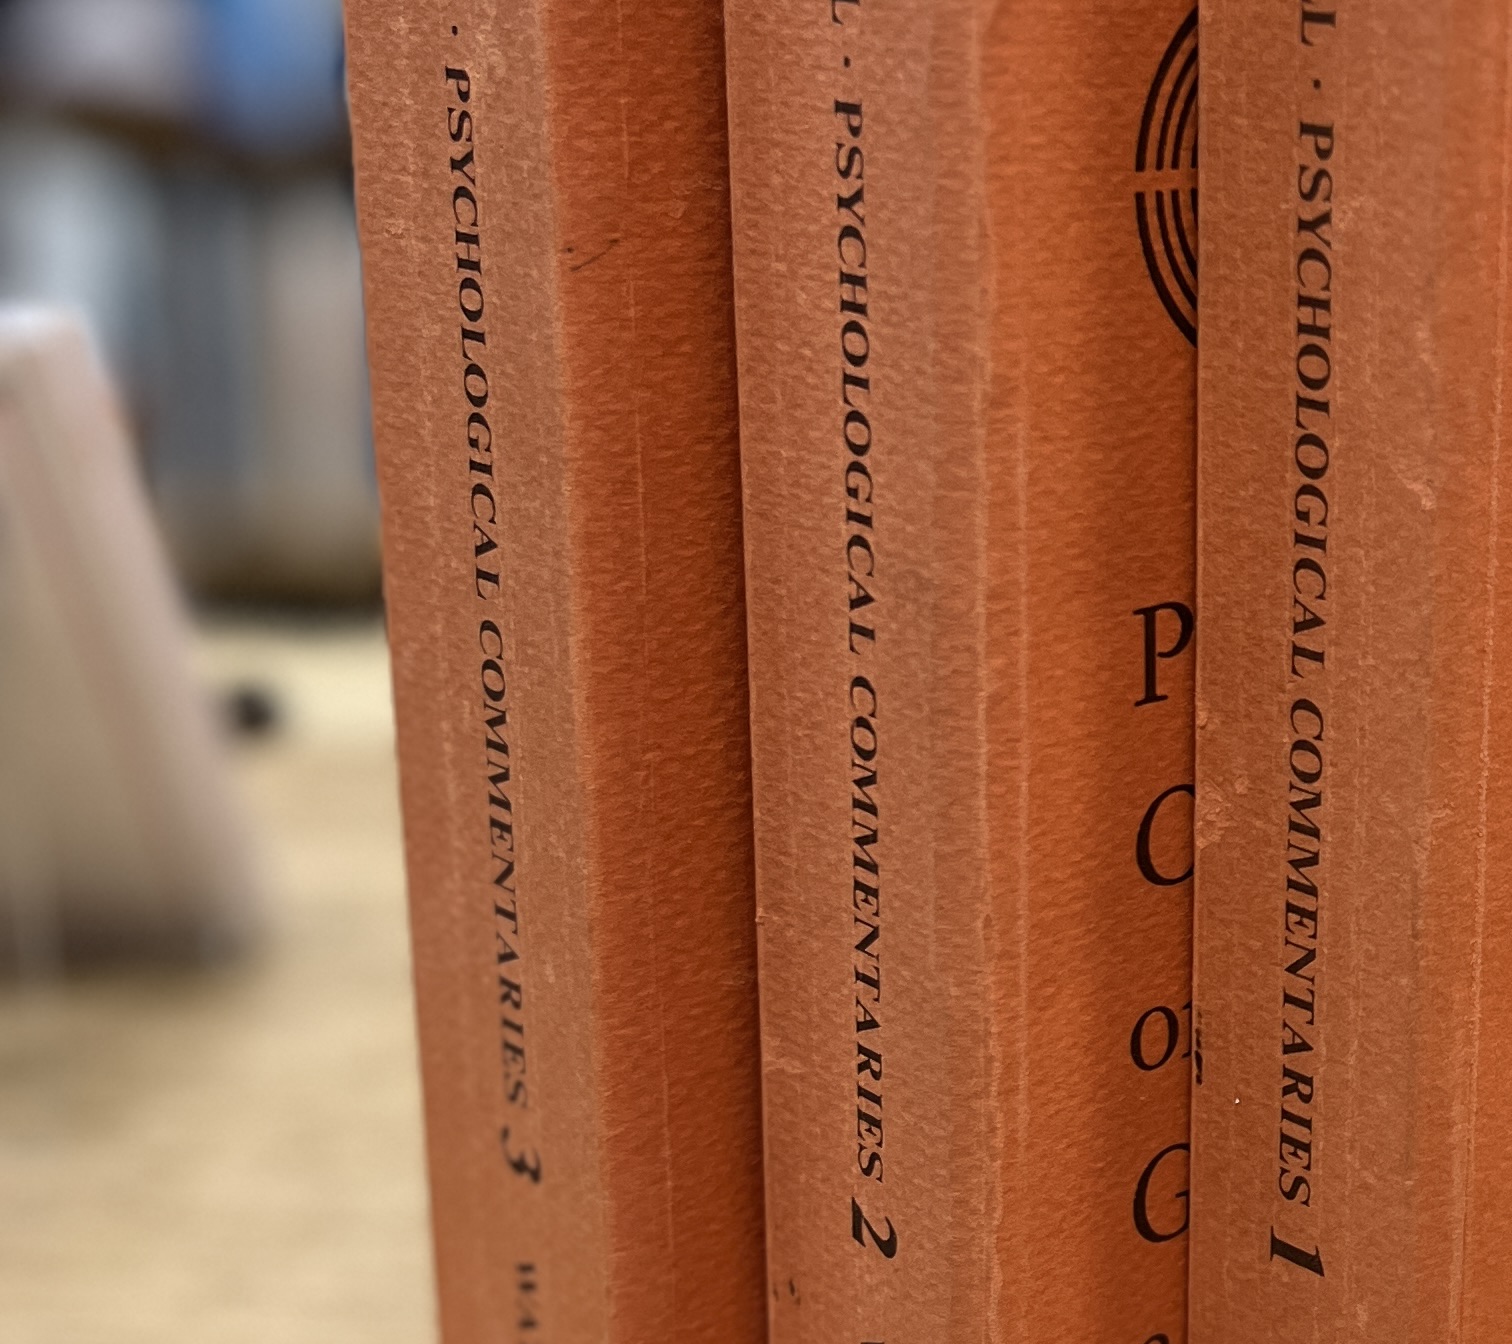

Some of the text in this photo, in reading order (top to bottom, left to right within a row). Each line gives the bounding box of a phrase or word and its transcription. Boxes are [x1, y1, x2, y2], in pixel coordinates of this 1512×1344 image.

[444, 64, 501, 601] PSYCHOLOGICAL
[834, 98, 877, 656] PSYCHOLOGICAL
[1290, 119, 1335, 679] PSYCHOLOGICAL
[478, 619, 530, 1109] COMMENTARIES
[848, 674, 887, 1184] COMMENTARIES
[1278, 698, 1324, 1207] COMMENTARIES
[500, 1126, 542, 1186] 3
[851, 1196, 898, 1259] 2
[1269, 1225, 1325, 1278] 1
